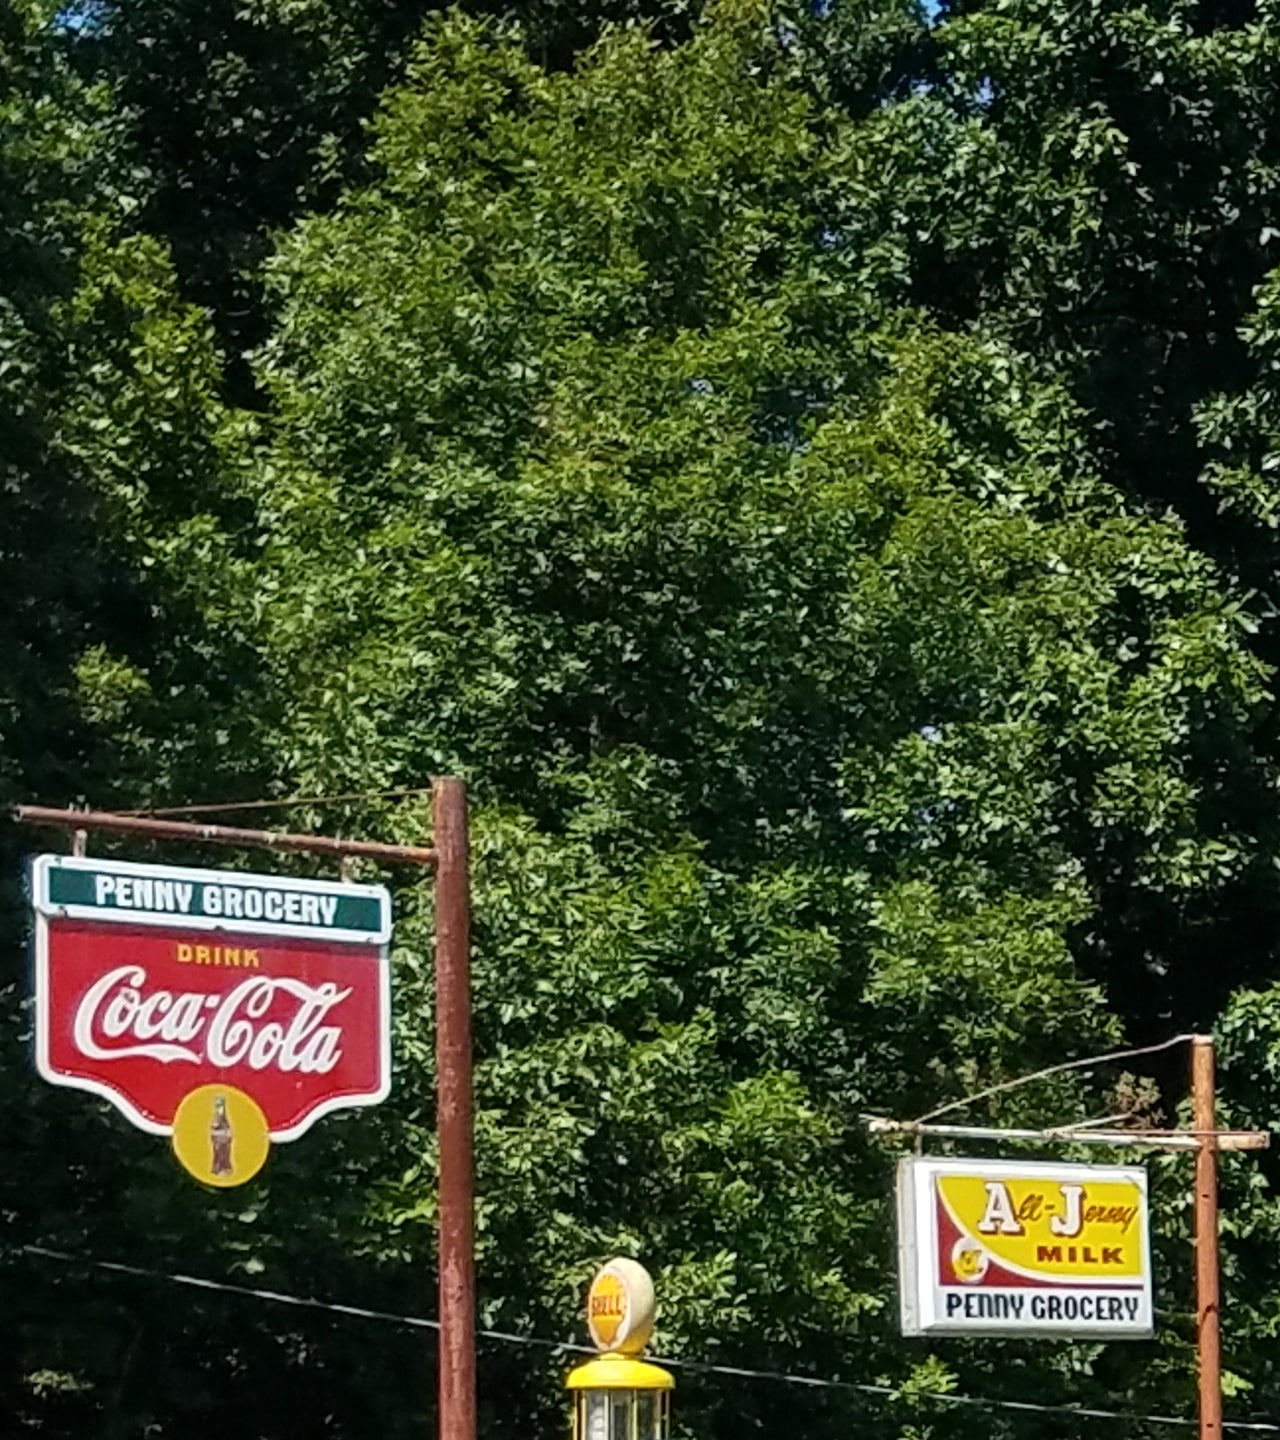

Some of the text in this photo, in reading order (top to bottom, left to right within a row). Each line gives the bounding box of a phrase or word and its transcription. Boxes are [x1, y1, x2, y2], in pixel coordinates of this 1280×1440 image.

[95, 875, 337, 926] PENNY GROCERY
[177, 944, 260, 967] DRINK
[74, 965, 353, 1073] Coca-Cola
[1037, 1246, 1125, 1264] MILK
[946, 1293, 1138, 1320] PENNY GROCERY
